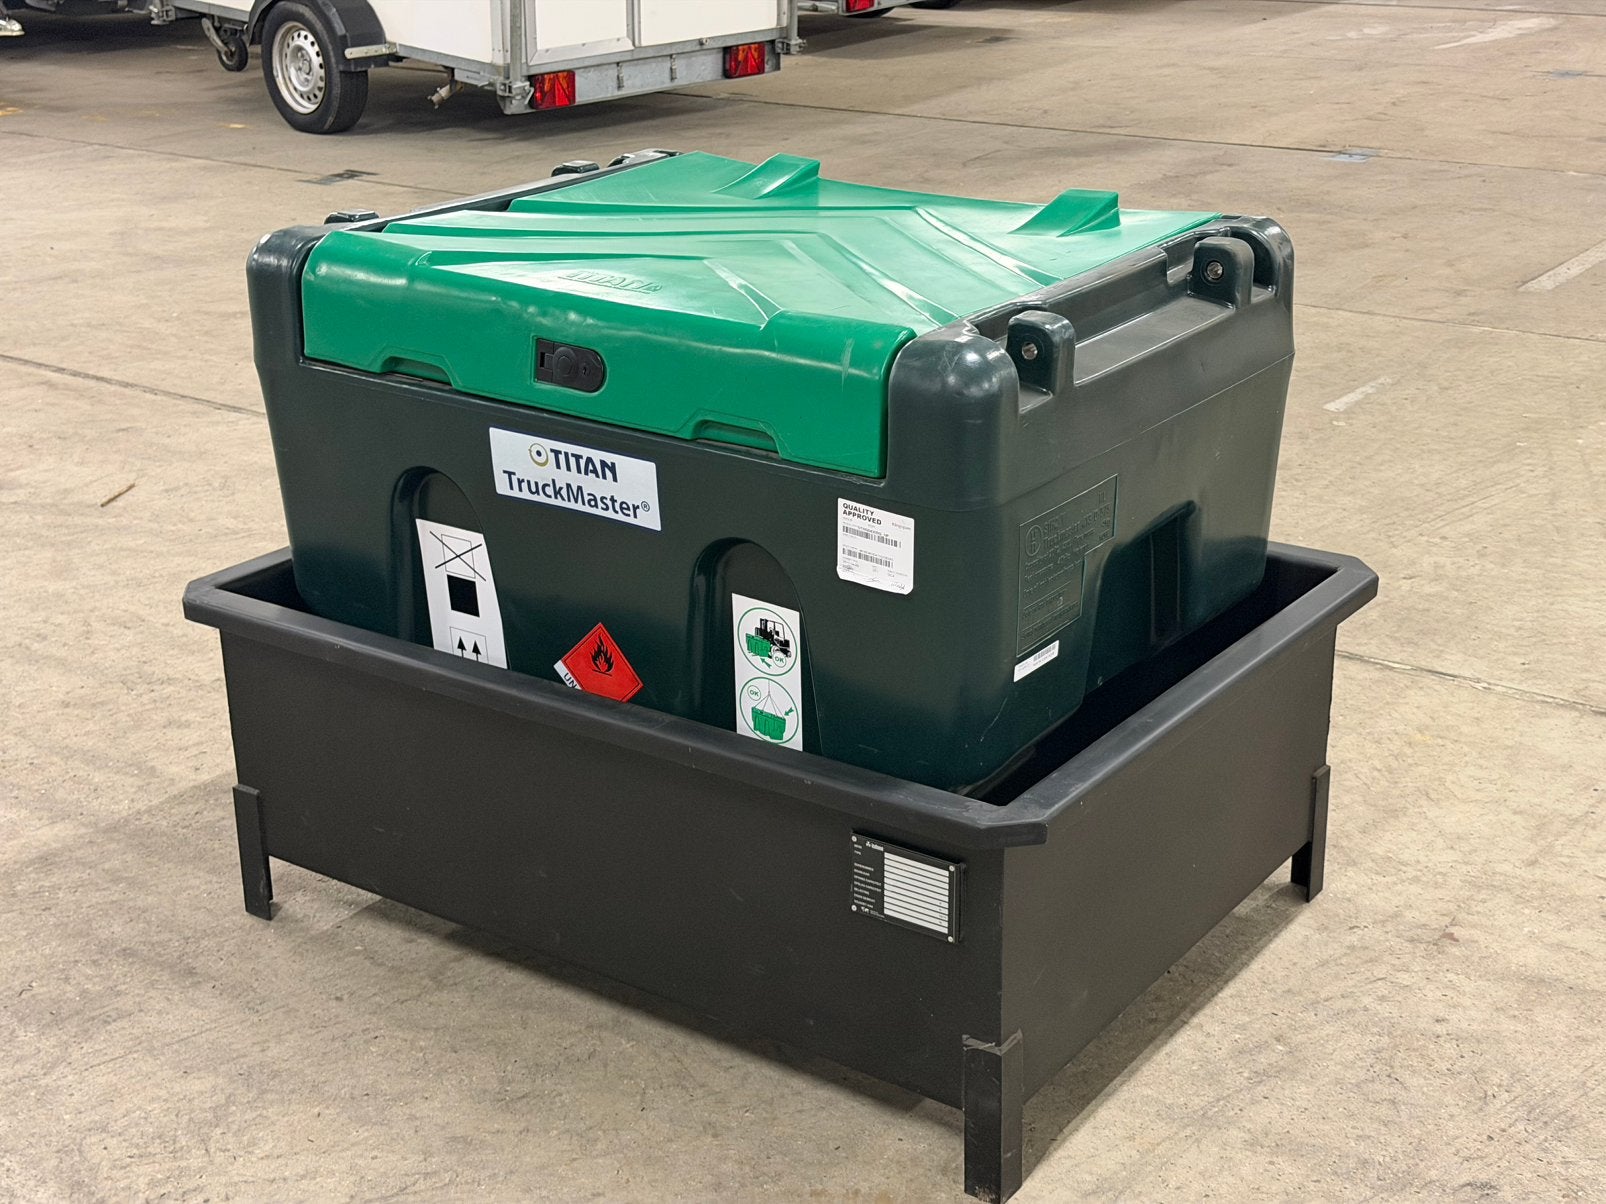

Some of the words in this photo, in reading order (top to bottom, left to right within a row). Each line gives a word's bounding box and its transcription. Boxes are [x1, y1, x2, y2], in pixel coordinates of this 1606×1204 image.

[550, 448, 618, 483] TITAN
[842, 502, 875, 516] QUALITY
[842, 509, 882, 525] APPROVED
[774, 656, 784, 664] OK
[749, 689, 759, 697] OK
